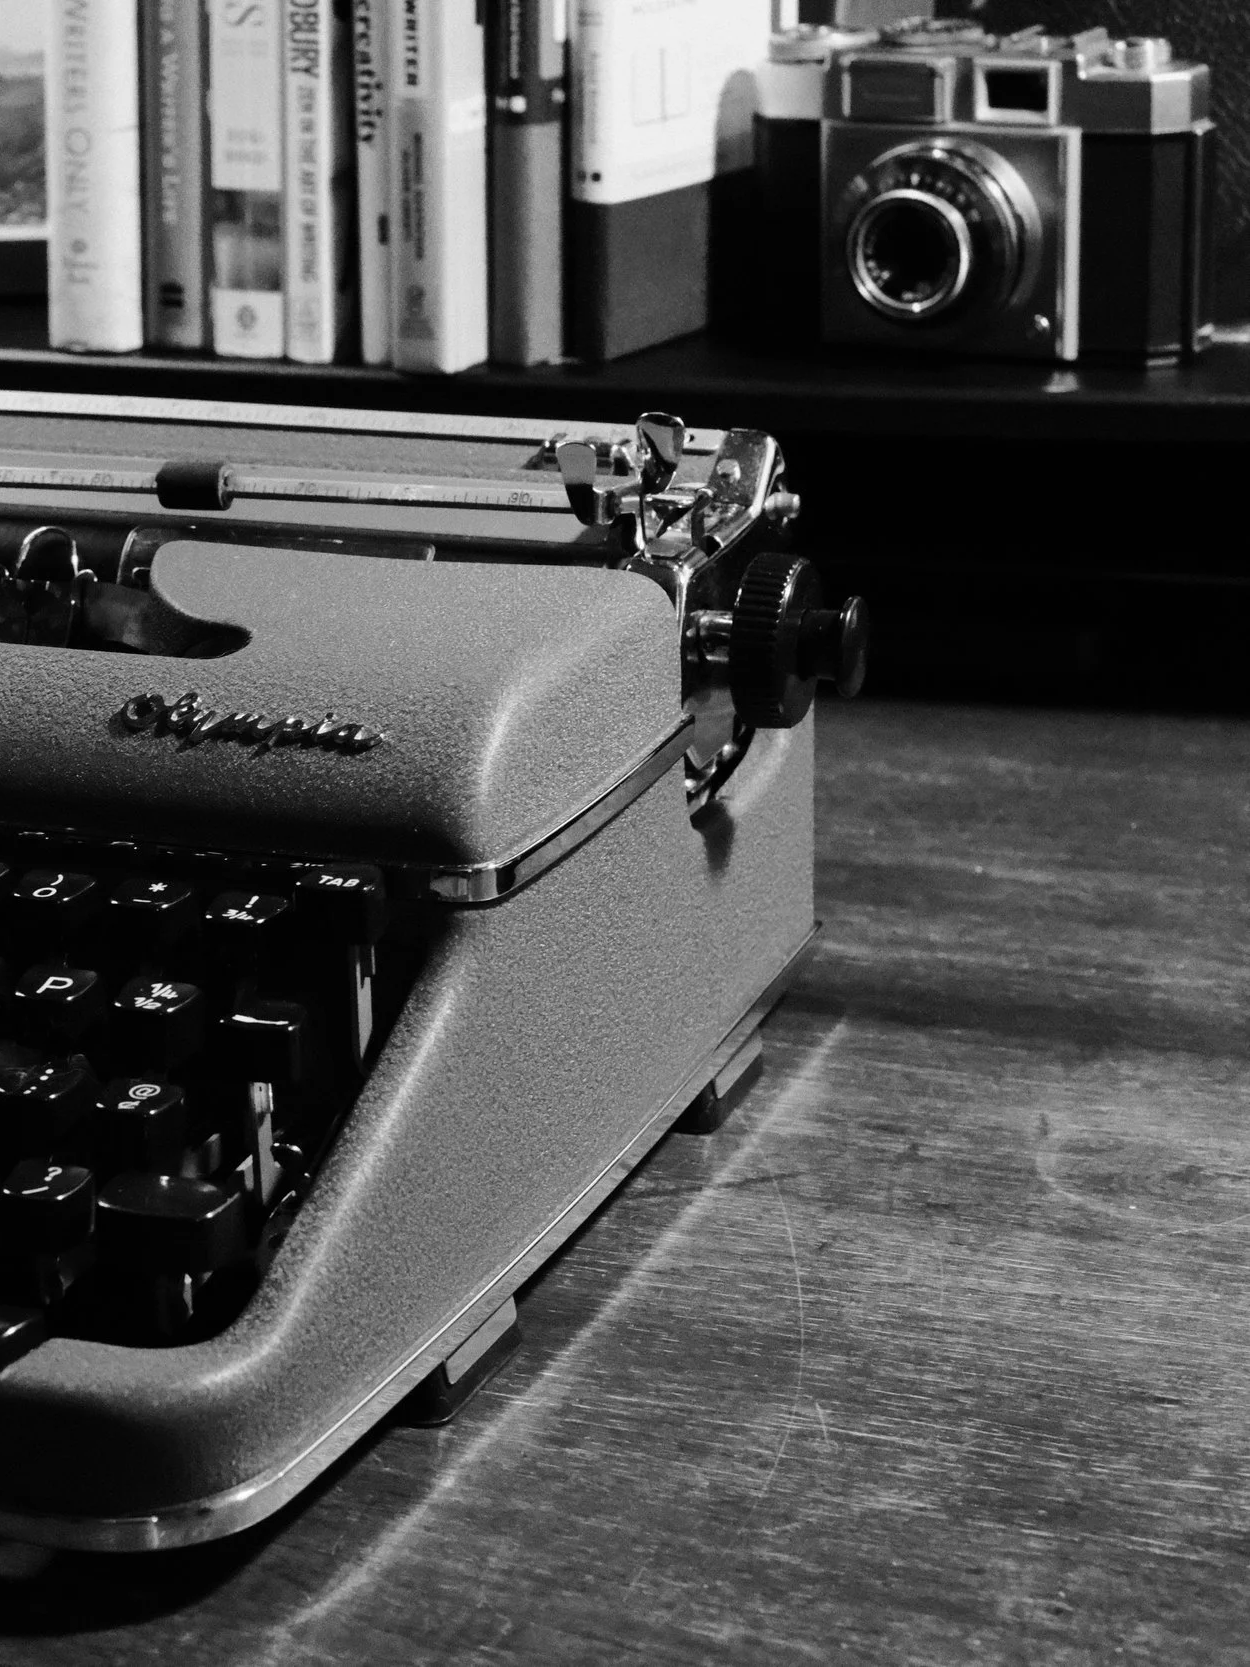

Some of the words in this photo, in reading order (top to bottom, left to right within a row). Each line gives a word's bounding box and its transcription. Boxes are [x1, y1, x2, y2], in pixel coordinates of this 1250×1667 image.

[116, 691, 384, 758] Olympia
[318, 875, 361, 888] TAB
[36, 976, 74, 994] P
[128, 1083, 162, 1100] @
